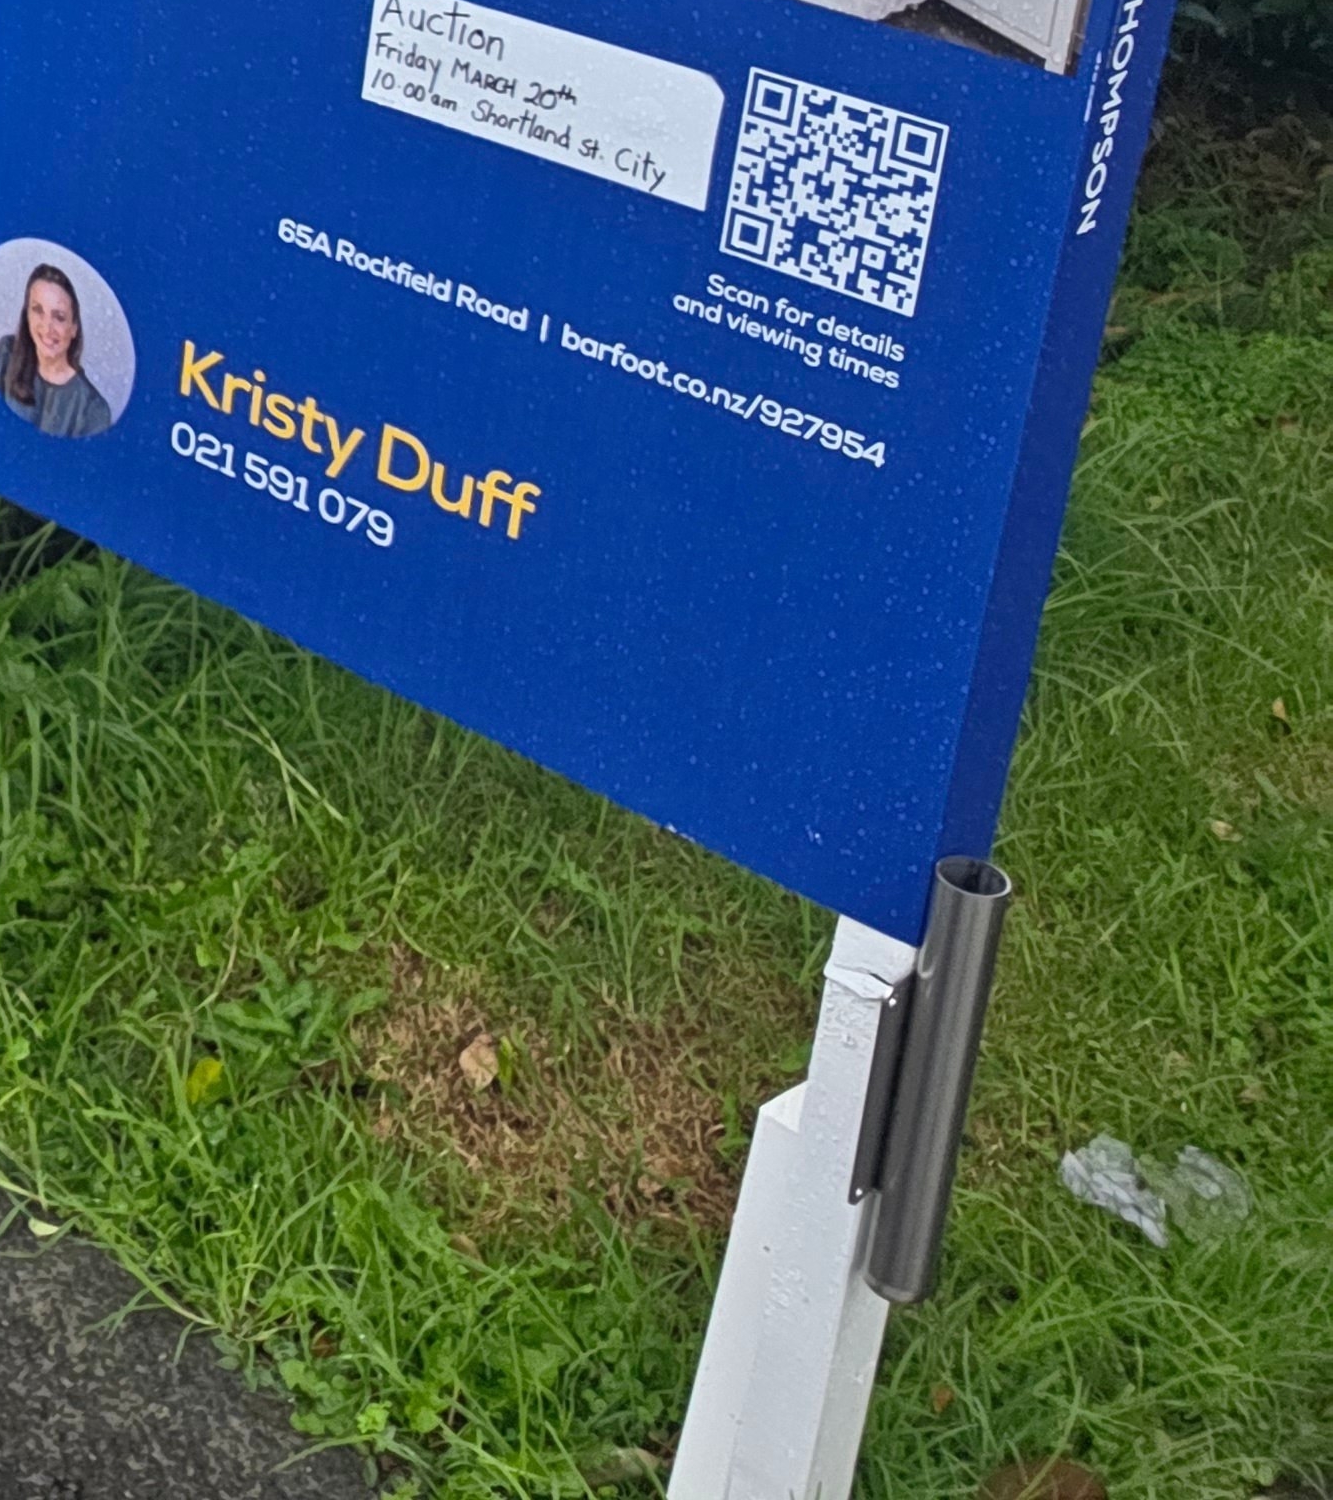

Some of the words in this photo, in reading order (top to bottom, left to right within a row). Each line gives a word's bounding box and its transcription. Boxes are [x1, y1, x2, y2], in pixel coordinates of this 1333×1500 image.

[375, 32, 441, 93] Friday
[470, 99, 571, 150] Shortland
[614, 147, 667, 192] City
[278, 218, 332, 259] 65A
[335, 241, 453, 304] Rockfield
[456, 285, 529, 331] Road
[561, 323, 887, 469] barfoot.co.nz/927954
[673, 294, 723, 325] and
[726, 312, 823, 368] viewing
[828, 346, 900, 389] times
[706, 273, 769, 315] Scan
[774, 298, 814, 328] for
[816, 316, 905, 362] details
[171, 421, 237, 479] 021
[243, 451, 311, 512] 591
[318, 487, 395, 548] 079
[180, 339, 366, 478] Kristy
[377, 423, 542, 540] Duff
